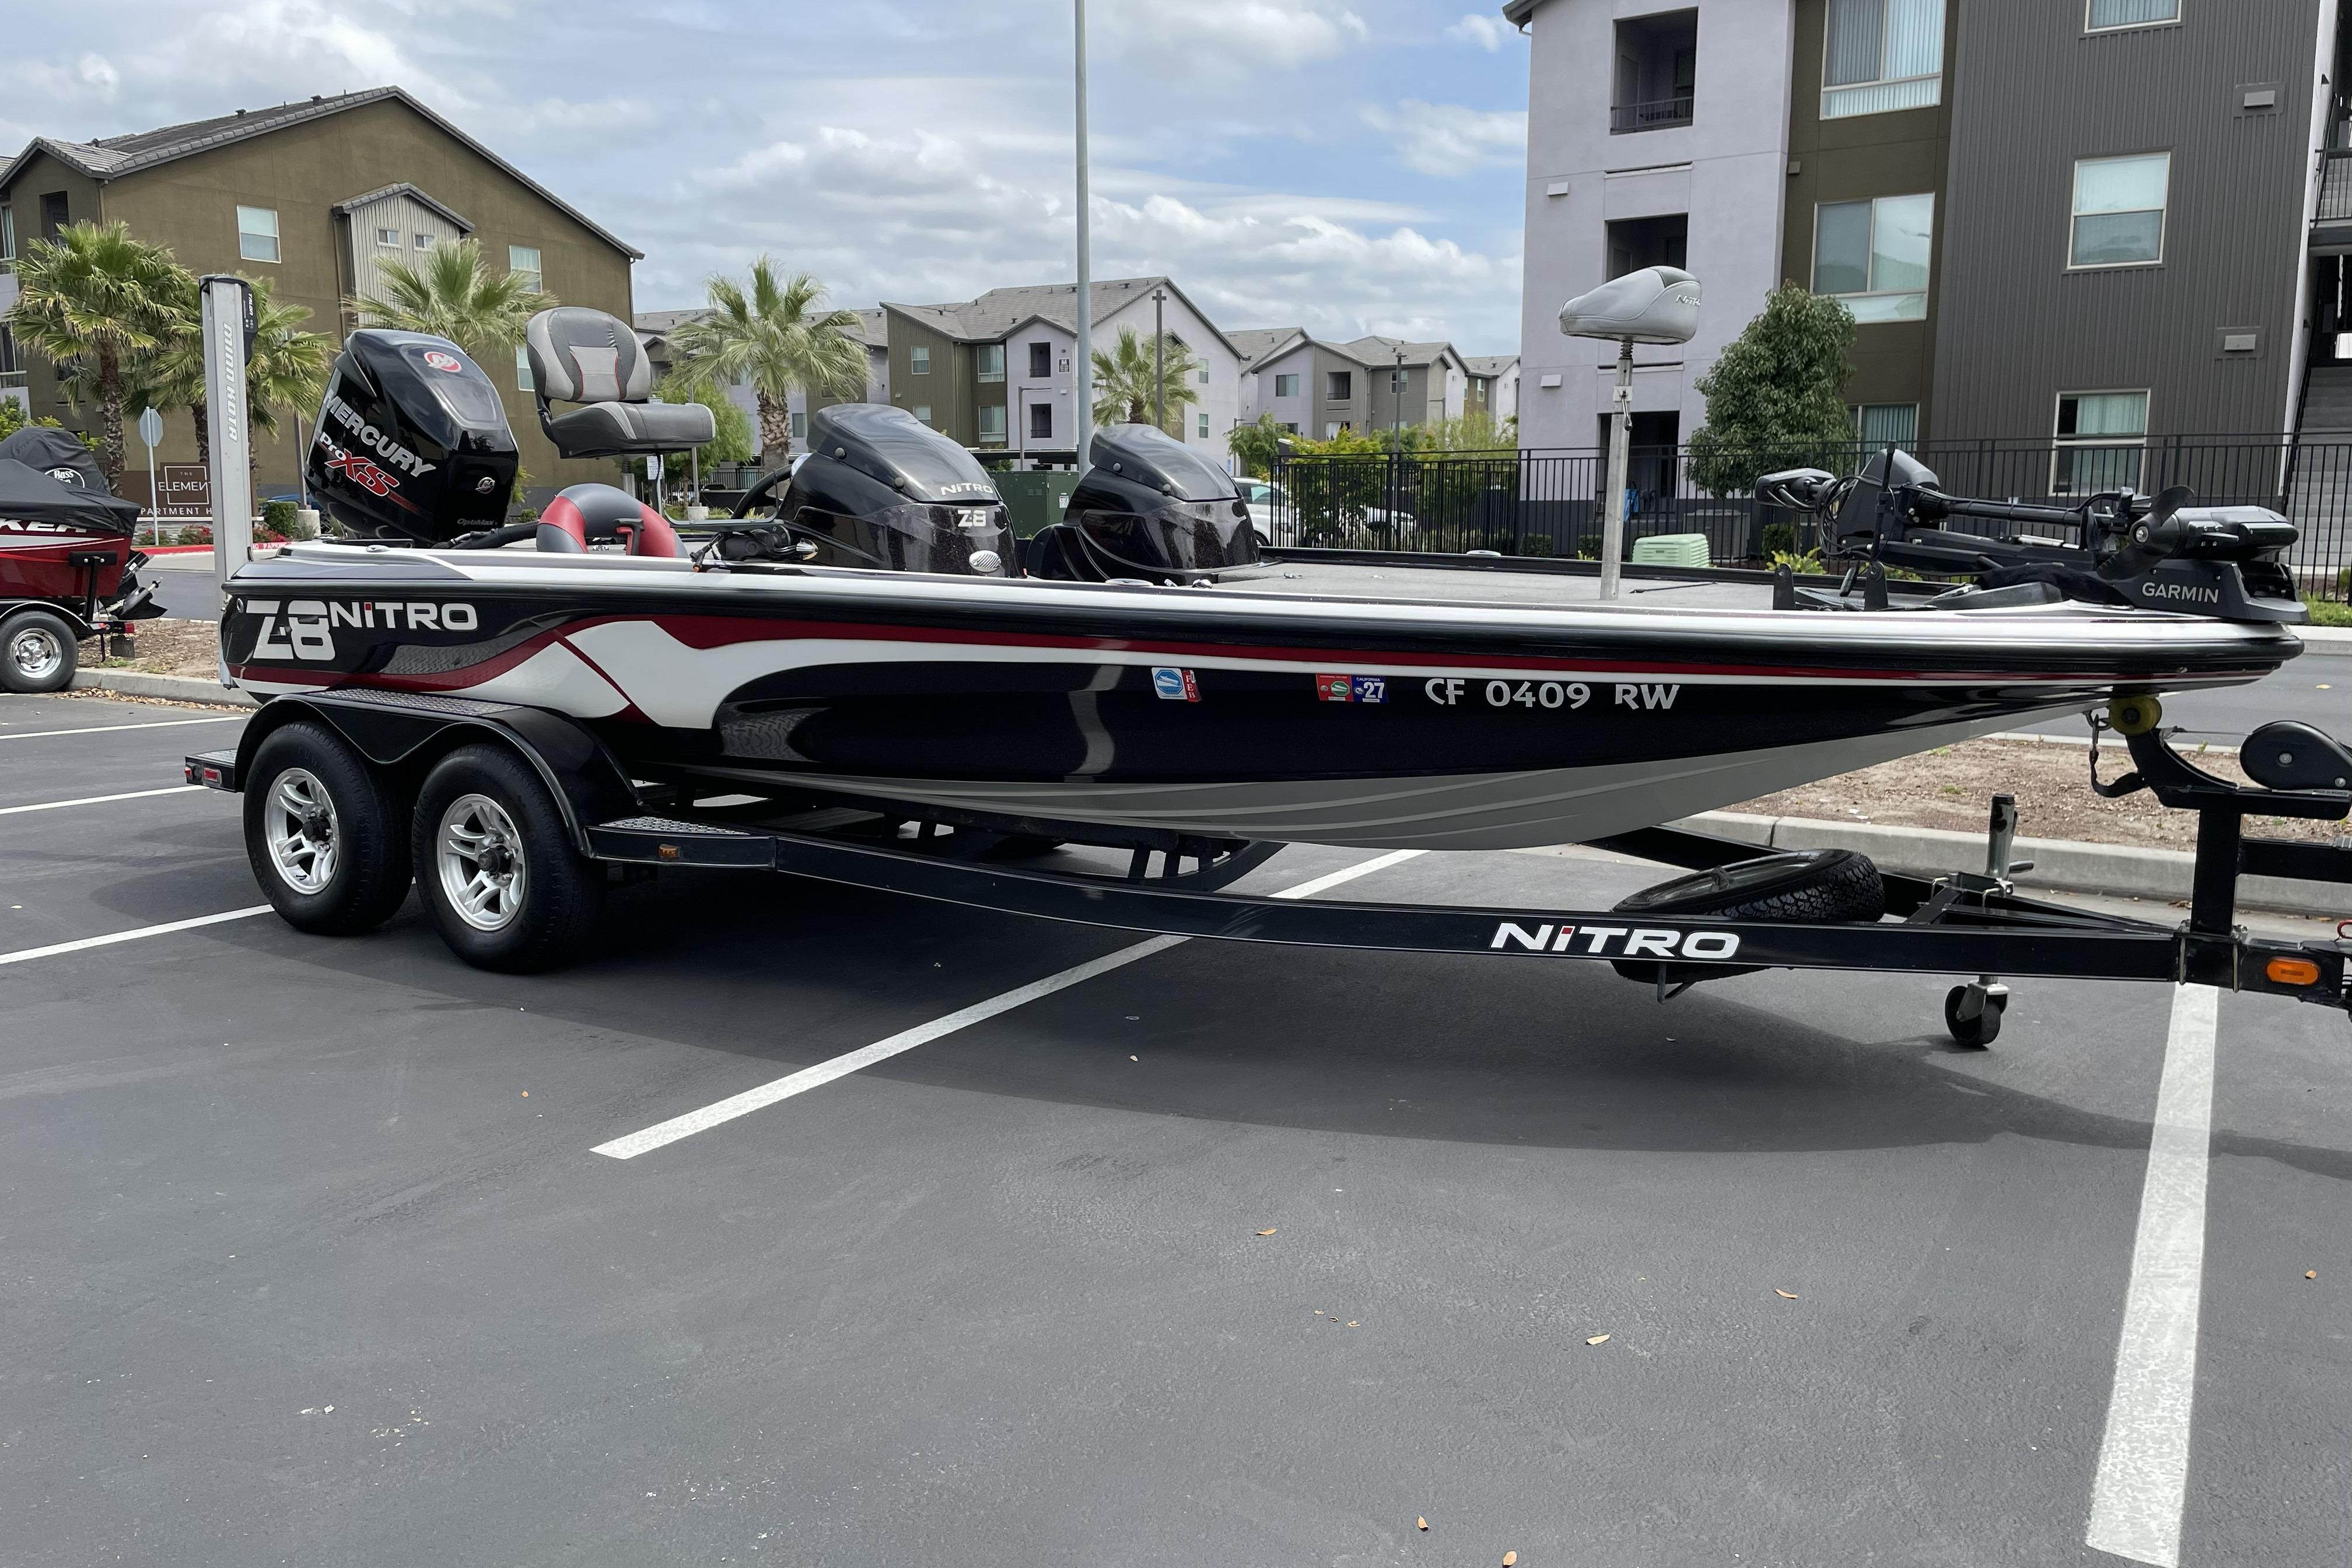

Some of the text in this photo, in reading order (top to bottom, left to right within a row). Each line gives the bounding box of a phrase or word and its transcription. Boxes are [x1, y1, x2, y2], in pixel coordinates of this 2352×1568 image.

[223, 323, 238, 442] MINN KOTA
[323, 388, 437, 477] MERCURY
[54, 470, 74, 479] Bass
[940, 482, 993, 496] NITRO
[2142, 582, 2219, 603] GARMIN
[329, 601, 478, 631] NITRO
[1363, 682, 1385, 699] 27
[1425, 678, 1680, 710] CF 0409 RW
[1490, 922, 1740, 959] NITRO
